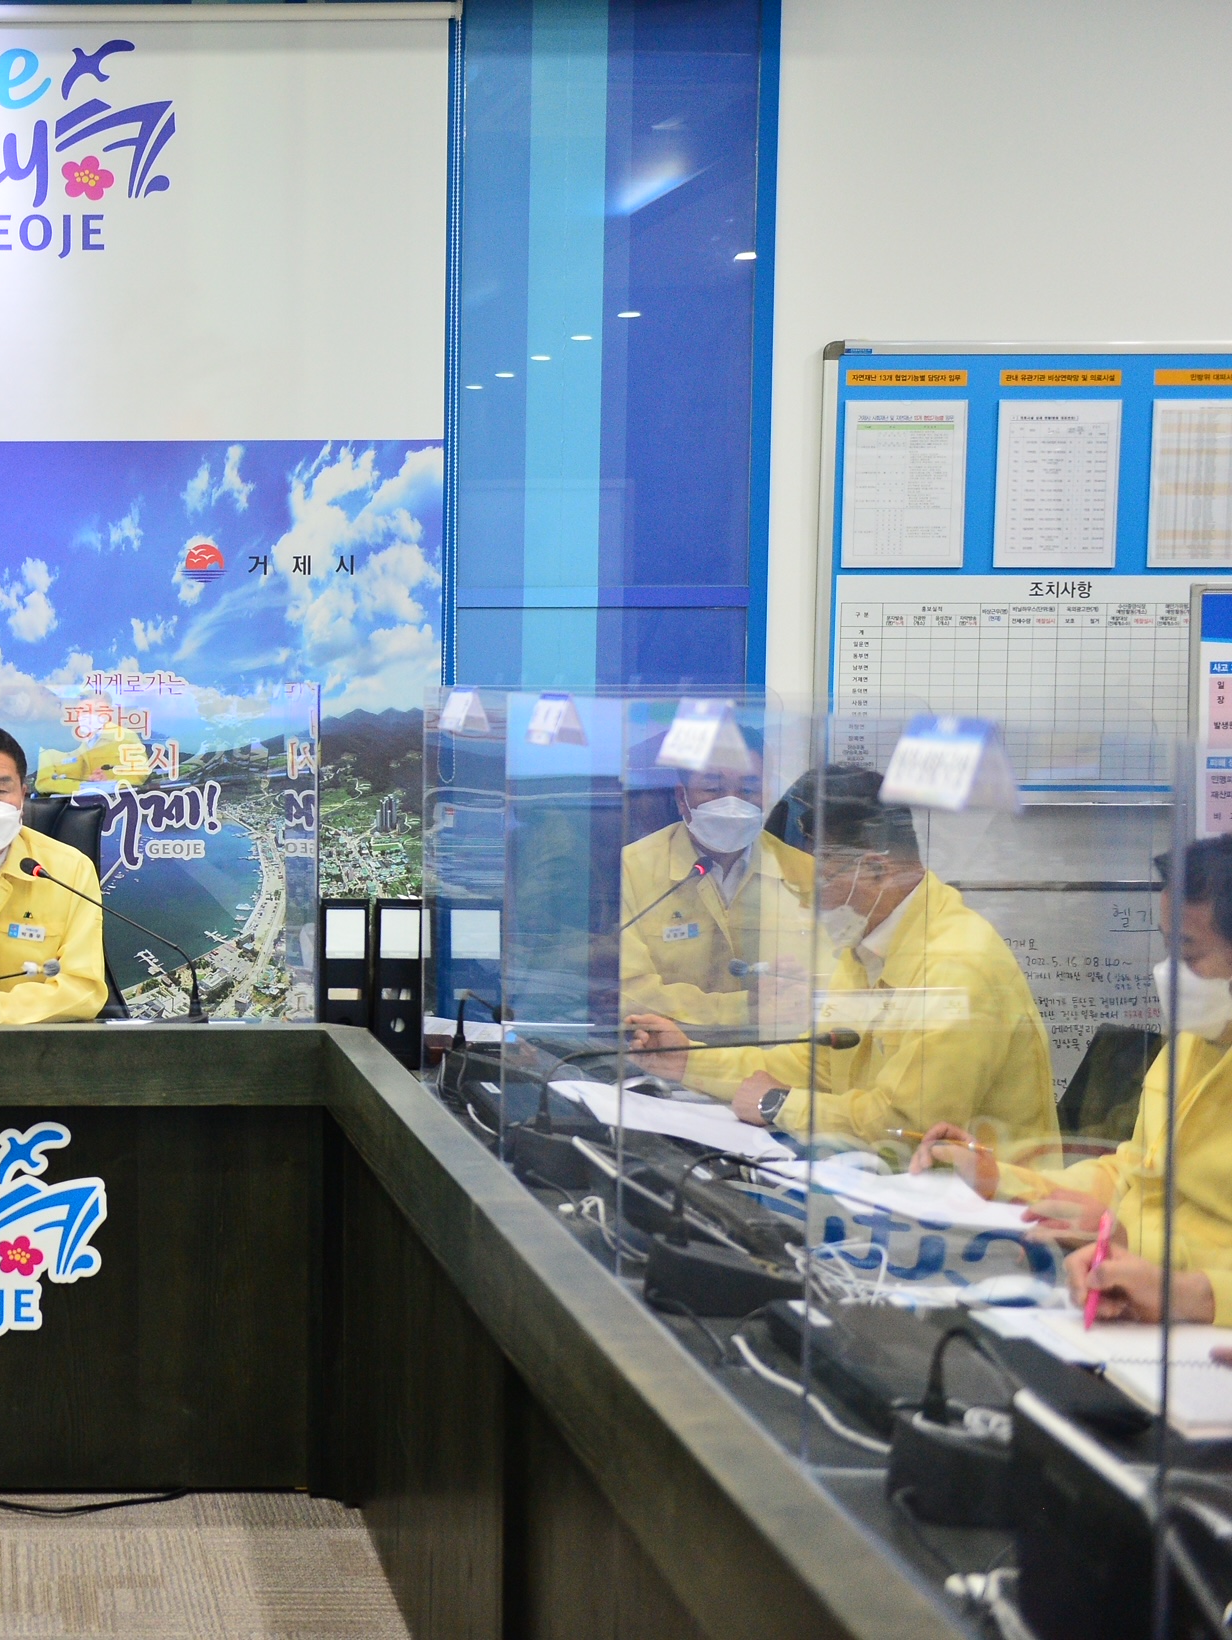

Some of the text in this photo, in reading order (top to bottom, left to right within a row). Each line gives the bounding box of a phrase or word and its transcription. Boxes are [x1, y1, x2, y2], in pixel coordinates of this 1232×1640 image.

[851, 374, 877, 382] 자연재난
[879, 374, 893, 382] 13개
[928, 374, 947, 382] 담당자
[949, 374, 961, 382] 임무
[1005, 374, 1115, 382] 관내 유관기관 비상연락망 및 의료시설
[1029, 581, 1092, 598] 조치사항
[1213, 663, 1228, 673] 사고
[84, 673, 186, 696] 세계로가는
[1217, 681, 1225, 690] 일
[64, 704, 149, 739] 평화의
[114, 742, 178, 778] 도시
[149, 842, 202, 857] GEOJE
